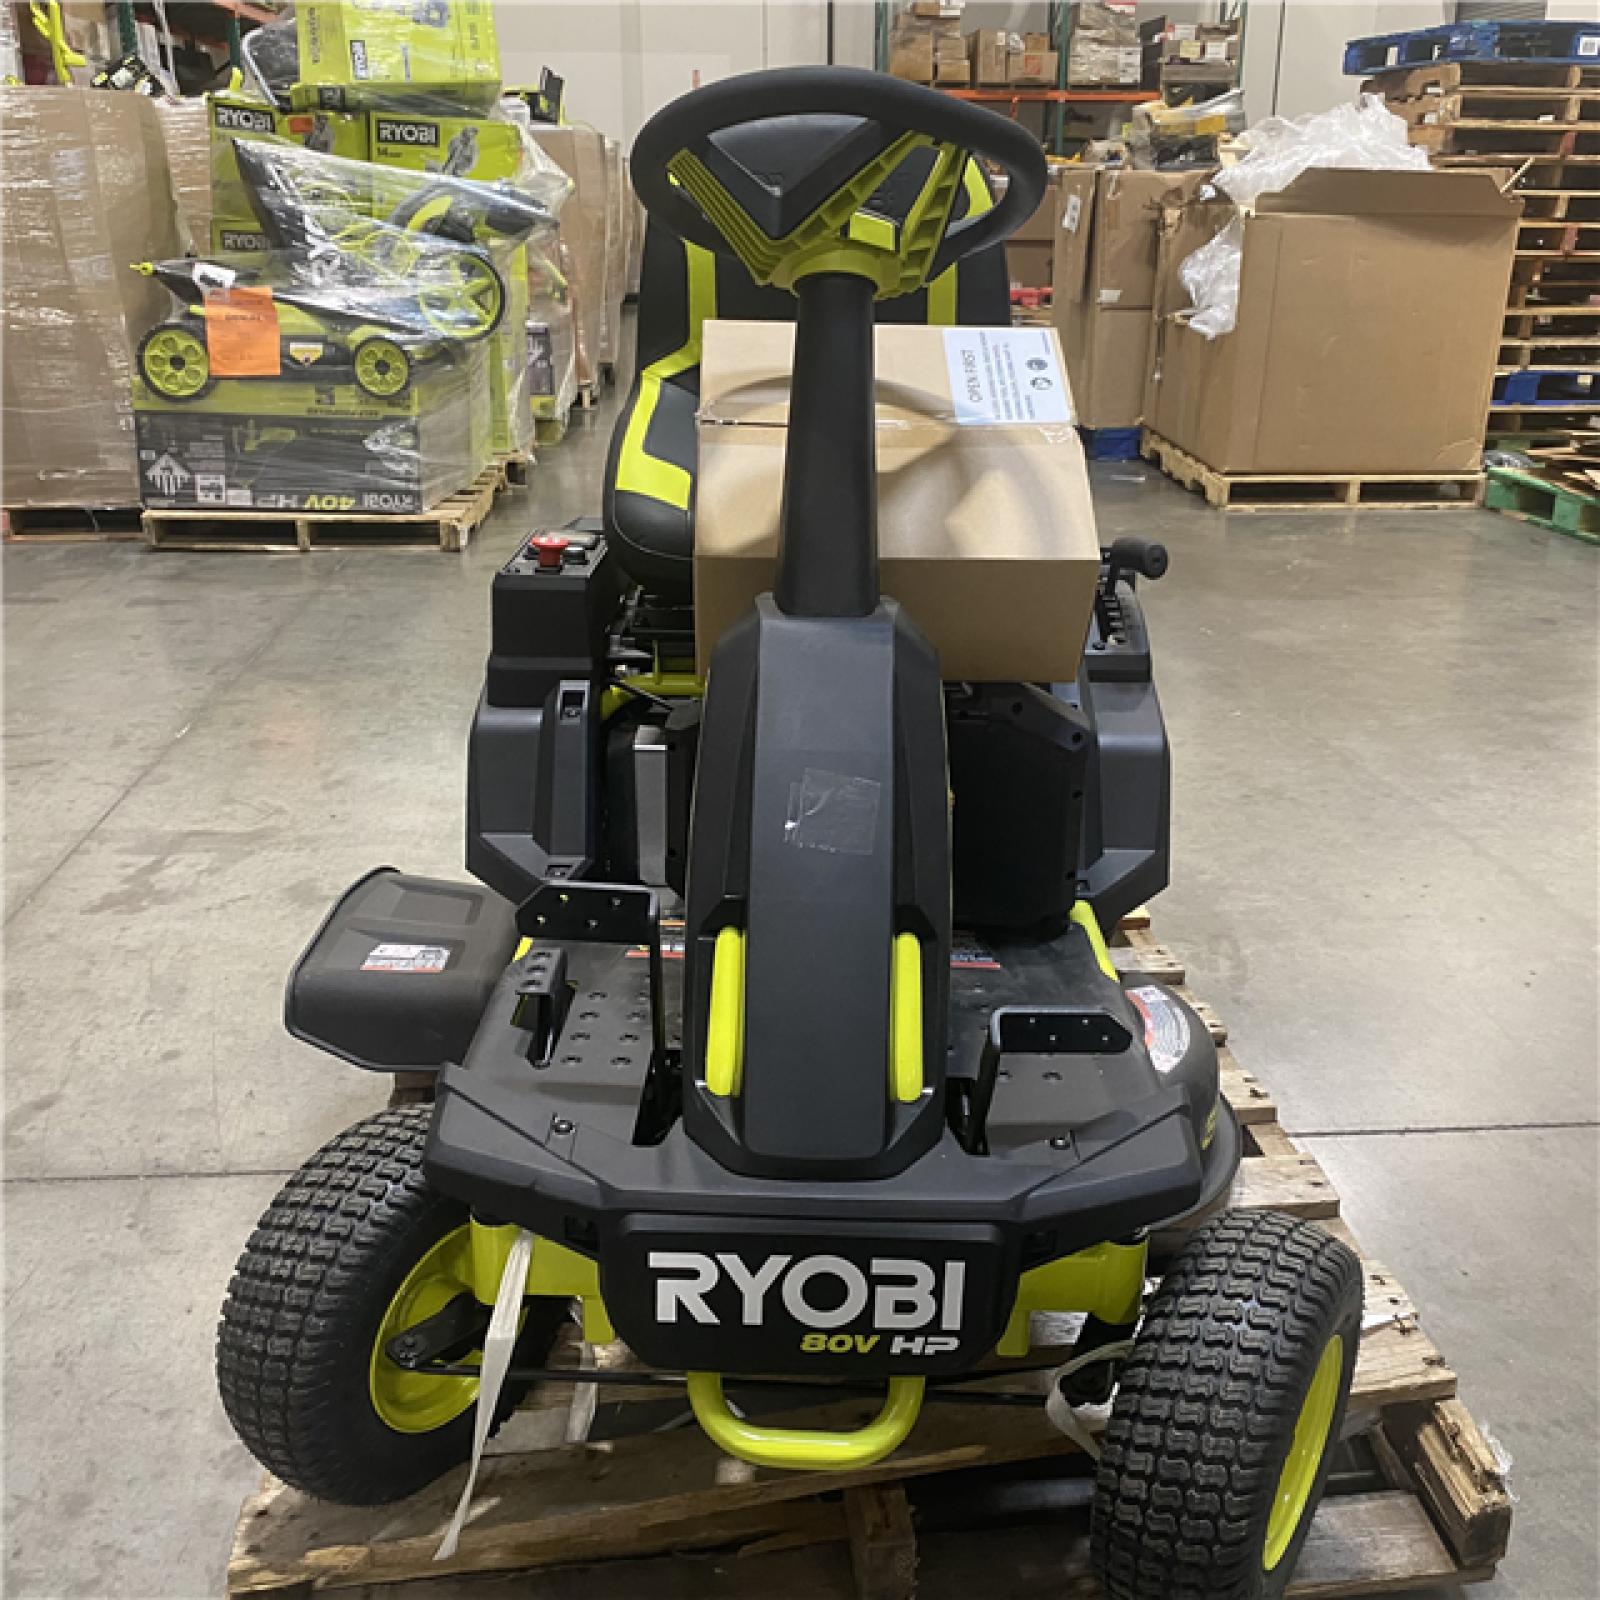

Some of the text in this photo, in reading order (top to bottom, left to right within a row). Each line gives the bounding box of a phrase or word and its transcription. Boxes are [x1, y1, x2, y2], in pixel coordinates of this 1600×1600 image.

[217, 106, 272, 131] RYOBI
[379, 121, 438, 144] RYOBI
[254, 492, 414, 510] RYOBI 40V HP
[647, 1251, 966, 1331] RYOBI
[799, 1334, 961, 1356] 80V HP
